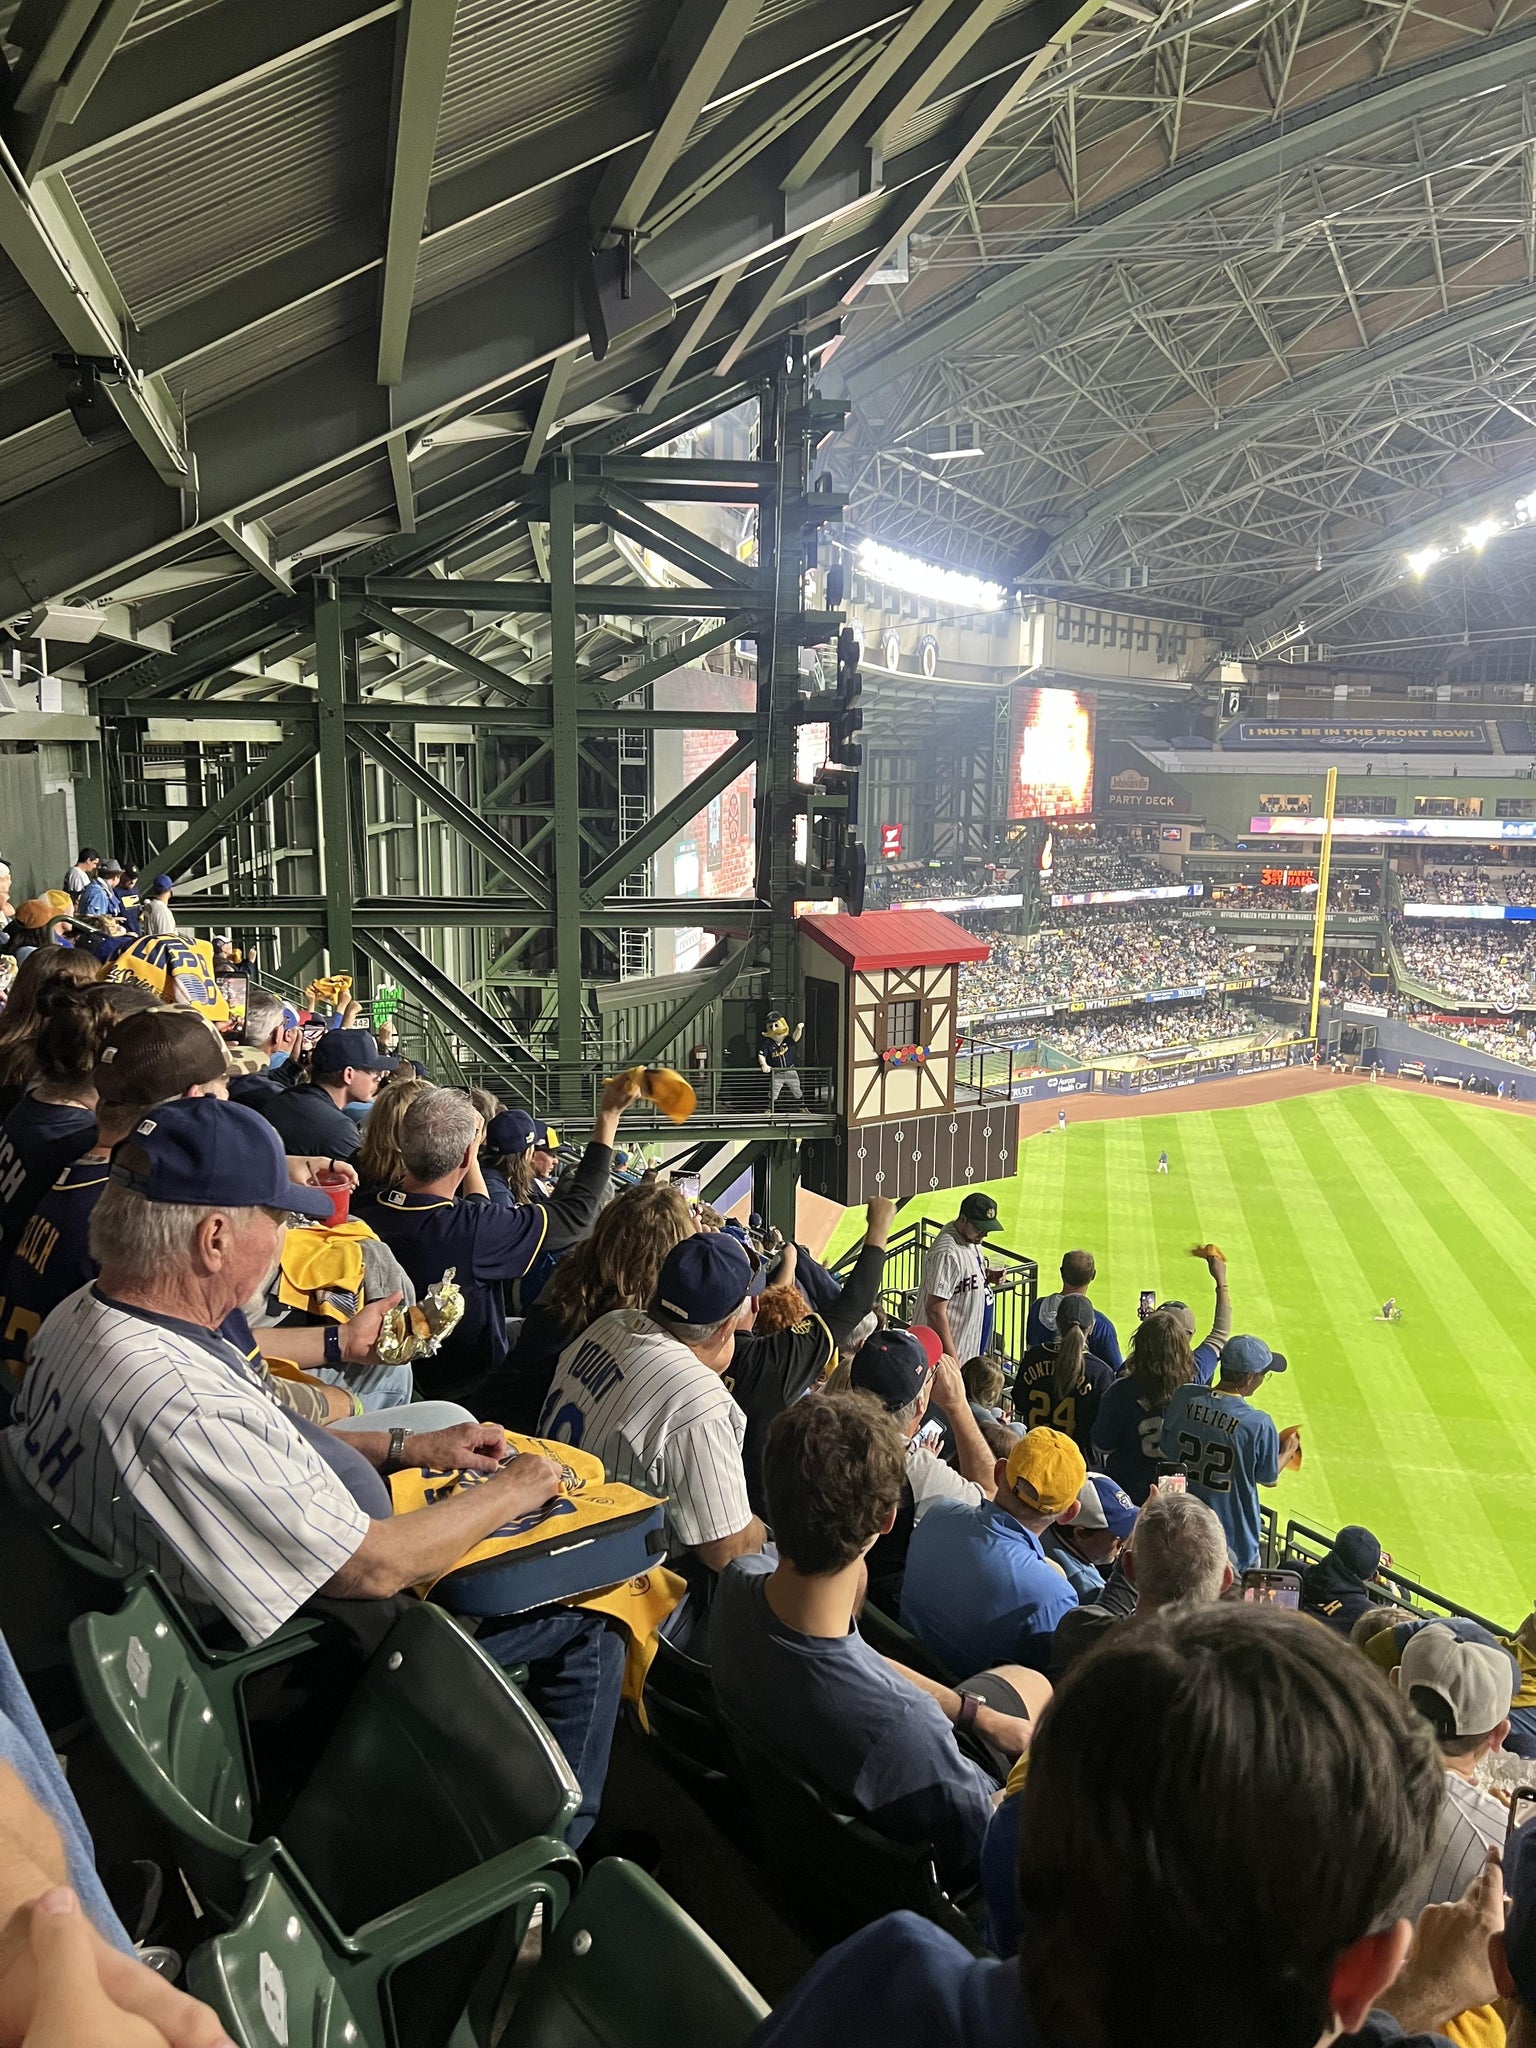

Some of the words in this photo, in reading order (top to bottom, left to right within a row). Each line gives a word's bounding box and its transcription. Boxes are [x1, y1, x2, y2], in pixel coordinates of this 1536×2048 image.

[1257, 728, 1298, 736] MUST
[1301, 728, 1321, 736] BE
[1324, 728, 1341, 736] IN
[1343, 728, 1374, 737] THE
[1377, 728, 1429, 738] FRONT
[1432, 730, 1476, 738] ROW!
[1109, 794, 1143, 805] PARTY
[1145, 796, 1175, 806] DECK
[1070, 1001, 1085, 1012] 620
[1086, 999, 1108, 1010] WTMJ
[352, 1019, 369, 1028] 442
[1058, 1083, 1075, 1093] Health
[1075, 1082, 1088, 1090] Care
[1059, 1077, 1076, 1086] Aurora
[567, 1338, 625, 1404] YOUNT
[1028, 1389, 1077, 1438] 24
[1186, 1403, 1240, 1435] YELICH
[1177, 1431, 1235, 1493] 22
